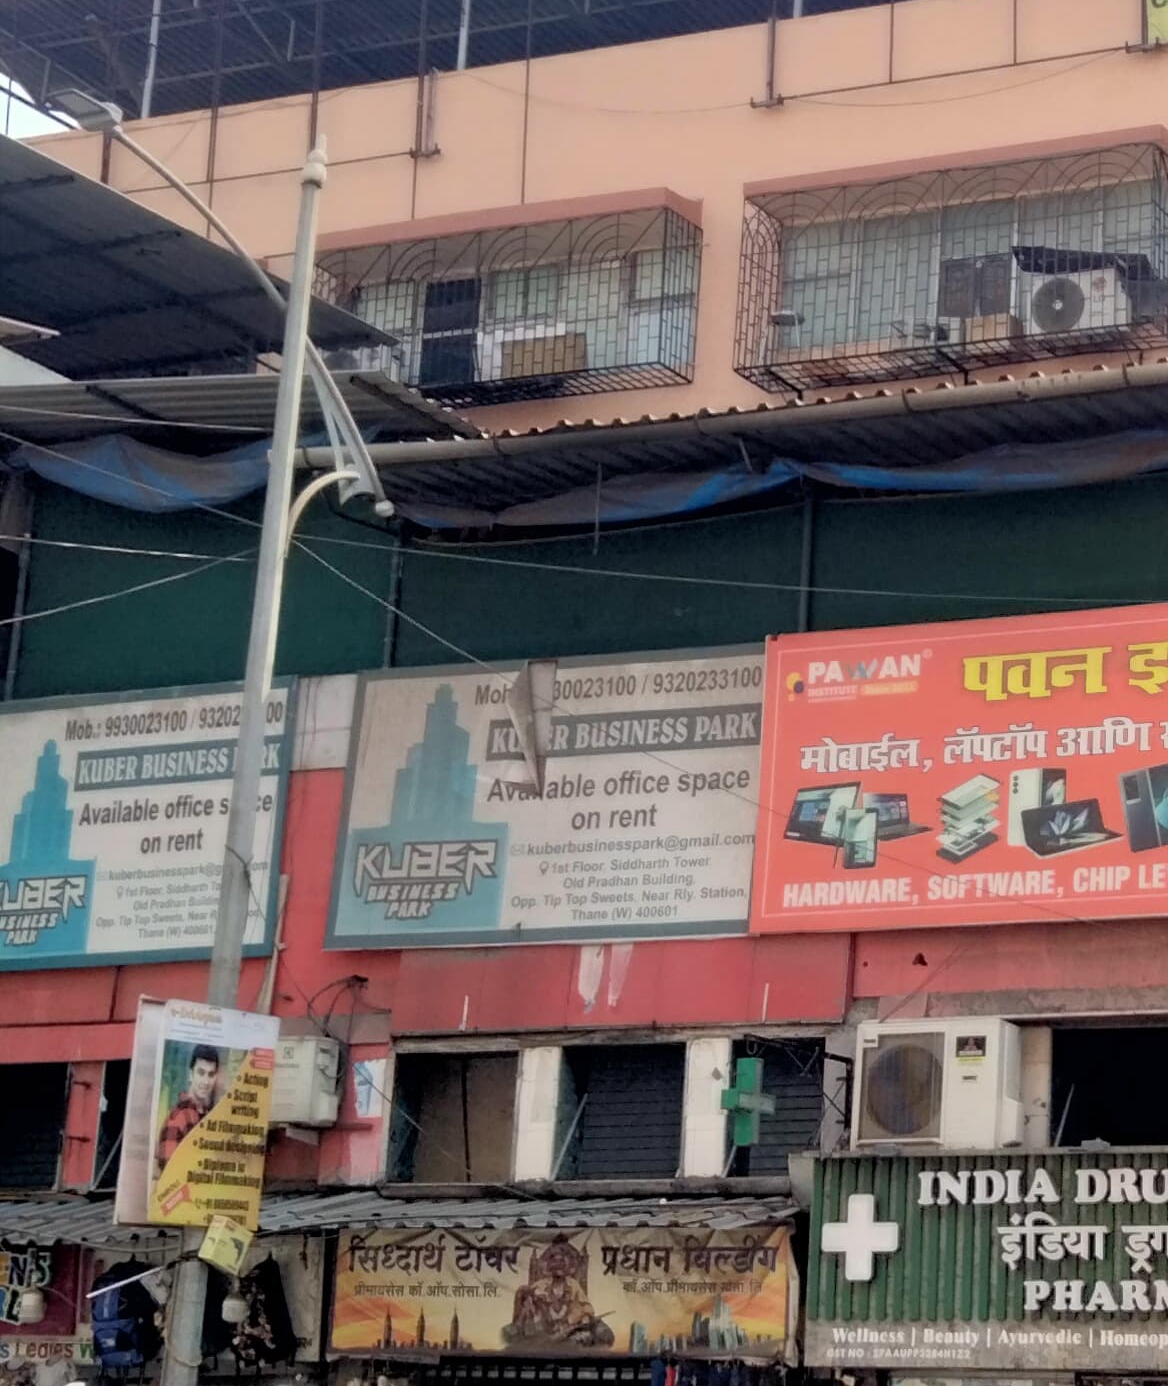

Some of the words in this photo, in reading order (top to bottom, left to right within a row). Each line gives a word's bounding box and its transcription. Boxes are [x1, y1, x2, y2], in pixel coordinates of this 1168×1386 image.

[653, 665, 762, 693] 9320233100
[808, 653, 921, 685] PAWAN
[963, 644, 1112, 702] पवन
[104, 710, 187, 737] 9930023100
[200, 701, 284, 730] 9320200
[574, 716, 688, 749] BUSINESS
[694, 711, 758, 742] PARK
[1056, 716, 1153, 758] आणि
[78, 755, 138, 785] KUBER
[142, 746, 229, 781] BUSINESS
[603, 770, 670, 797] office
[677, 769, 750, 797] space
[79, 799, 159, 827] Available
[165, 794, 215, 820] office
[571, 810, 600, 830] on
[608, 804, 657, 829] rent
[140, 834, 162, 854] on
[168, 828, 204, 853] rent
[527, 833, 756, 856] kuberbusinesspark@gmail.com
[353, 839, 498, 897] KUBER
[551, 860, 569, 873] 1st
[610, 856, 669, 872] Siddharth
[364, 881, 461, 904] BUSINESS
[563, 876, 584, 889] Old
[588, 873, 638, 889] Pradhan
[783, 877, 920, 908] HARDWARE,
[927, 869, 1064, 901] SOFTWARE,
[1072, 865, 1131, 892] CHIP
[0, 875, 88, 925] UBER
[384, 900, 432, 920] PARK
[543, 893, 562, 909] Tip
[566, 892, 587, 909] Top
[641, 888, 670, 902] Near
[571, 908, 608, 921] Thane
[611, 906, 632, 921] (W)
[916, 1168, 1060, 1206] INDIA
[998, 1212, 1109, 1269] इंडिया
[832, 1327, 905, 1345] Wellness
[923, 1327, 980, 1348] Beauty
[997, 1328, 1082, 1347] Ayurvedic
